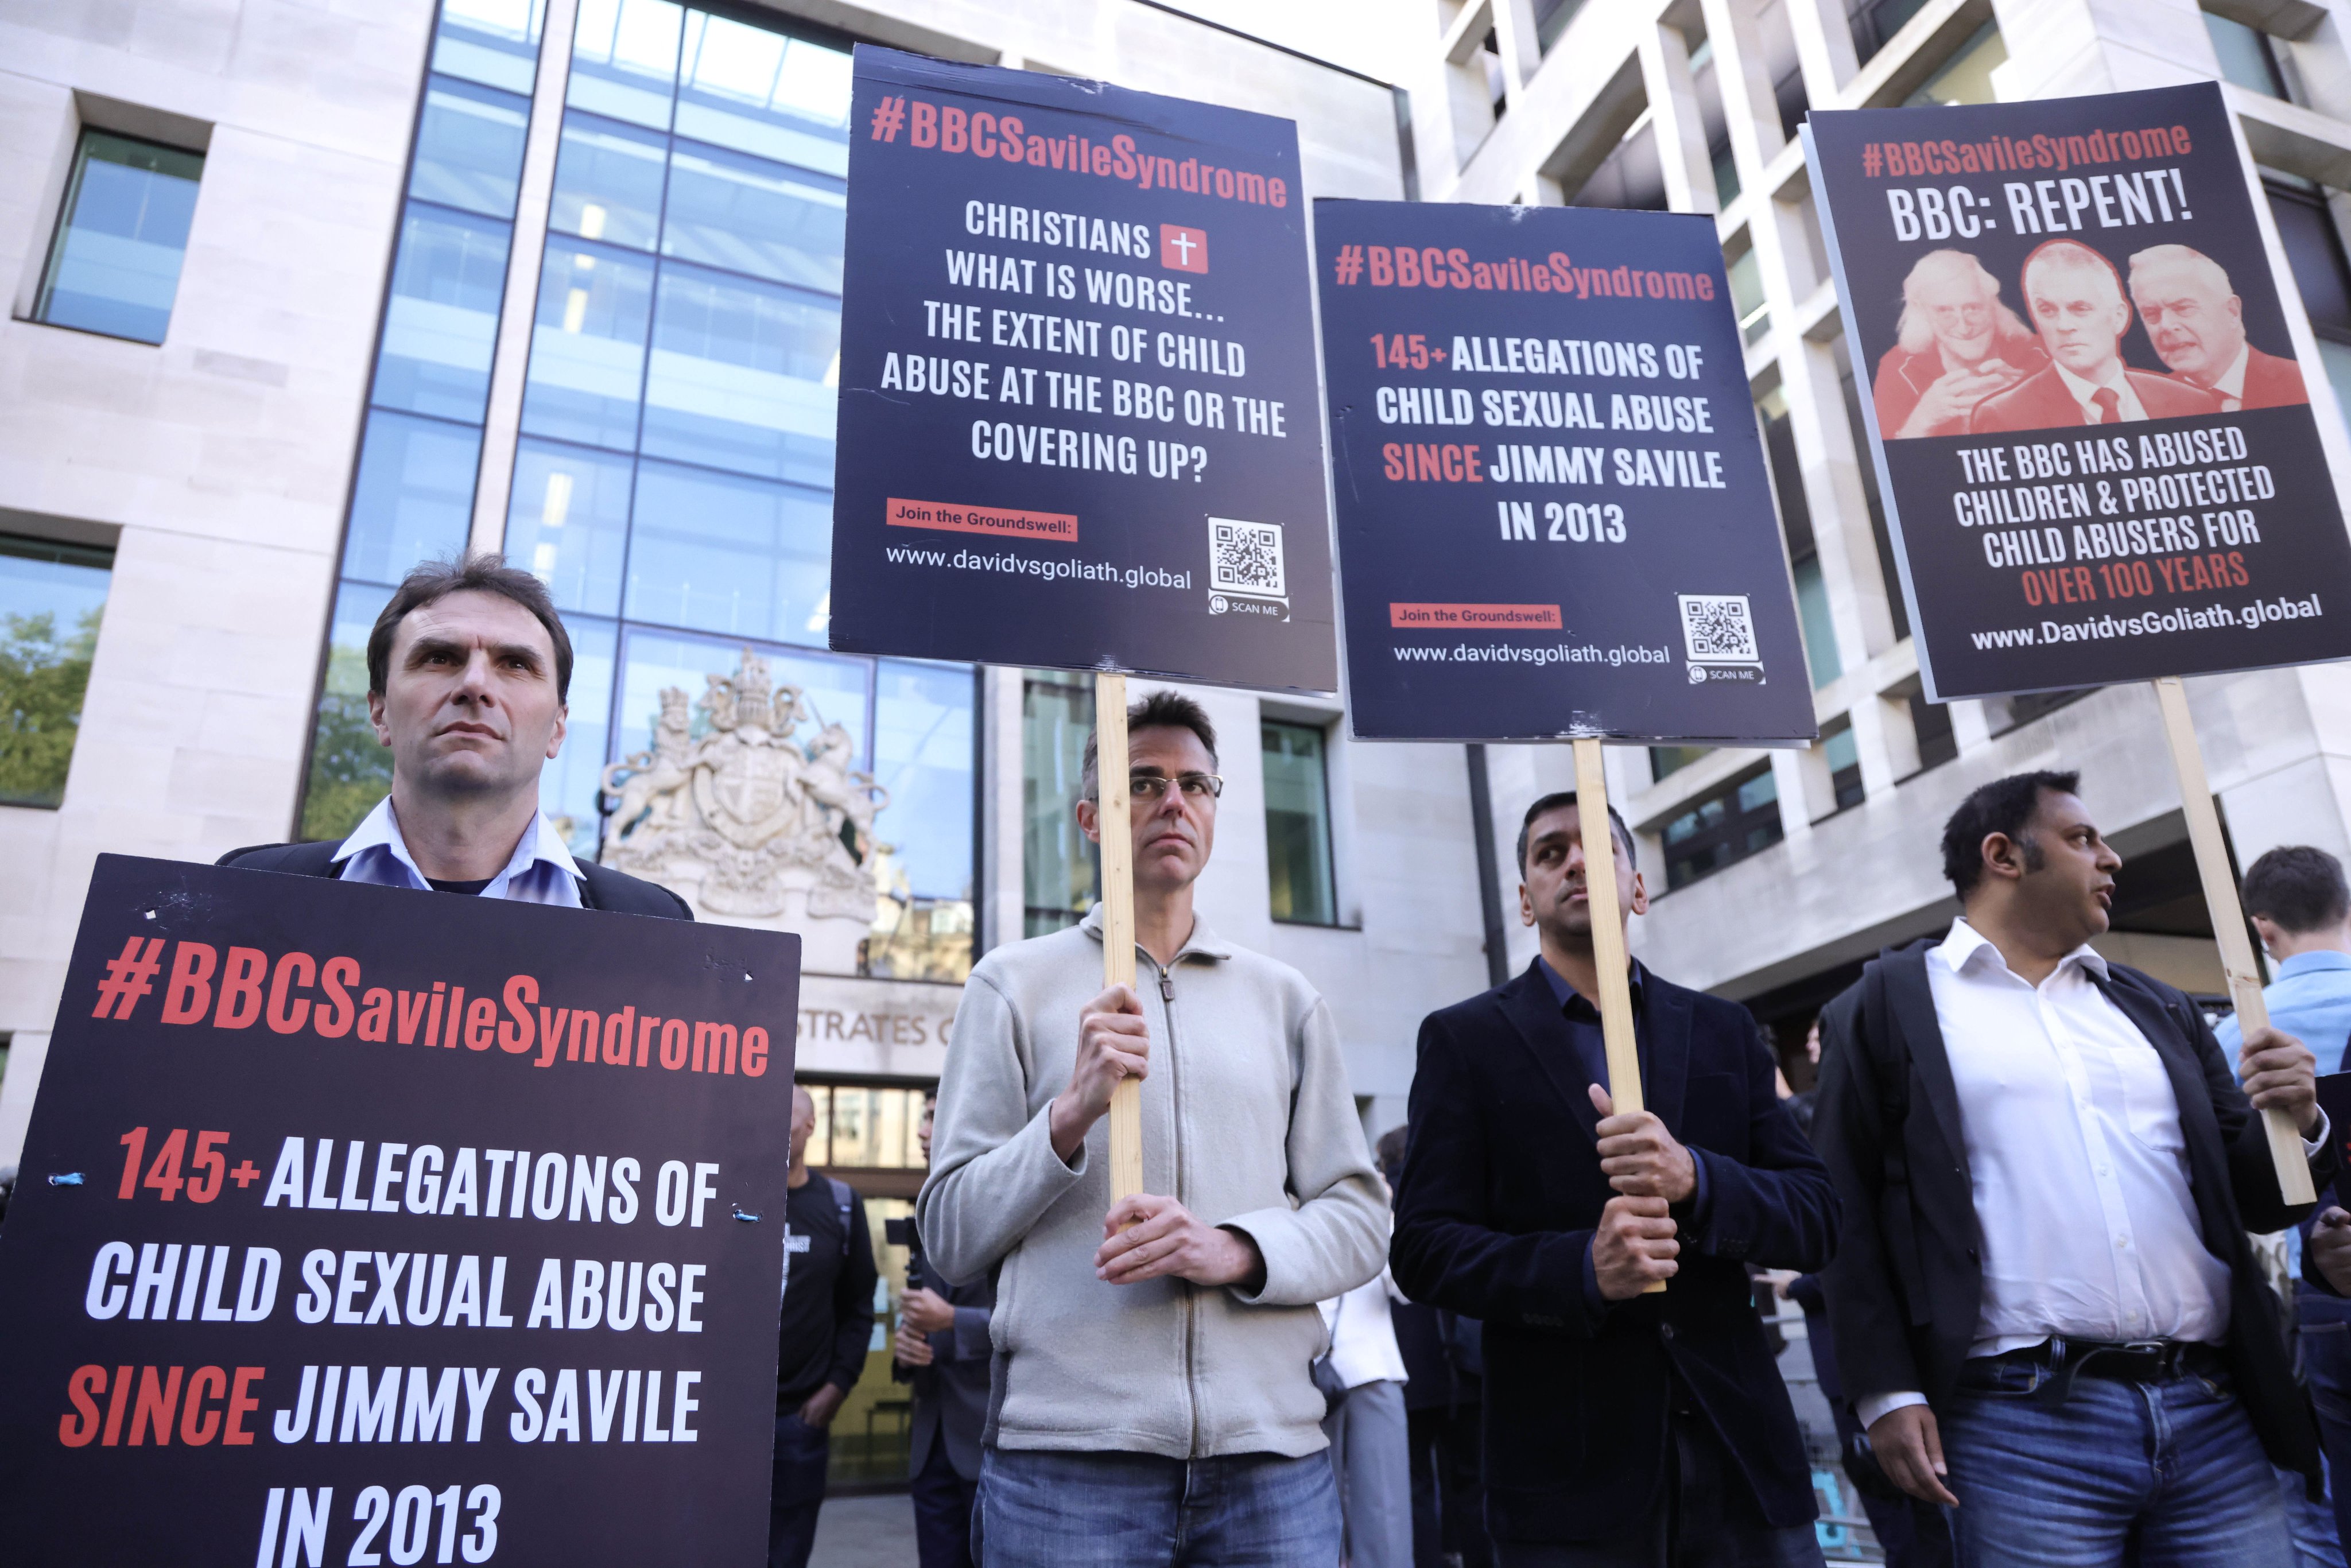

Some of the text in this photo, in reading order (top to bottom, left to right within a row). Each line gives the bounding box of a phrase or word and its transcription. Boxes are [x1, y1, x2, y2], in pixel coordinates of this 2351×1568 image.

[871, 96, 1286, 208] #BBCSavileSyndrome
[1863, 125, 2193, 177] #BBCSavileSyndrome
[966, 200, 1150, 259] CHRISTIANS
[1886, 168, 2193, 241] BBC: REPENT!
[946, 249, 1224, 323] WHAT IS WORSE...
[1335, 245, 1714, 301] #BBCSavileSyndrome
[924, 300, 1246, 377] THE EXTENT OF CHILD
[1371, 334, 1703, 379] 145+ ALLEGATIONS OF
[881, 352, 1287, 438] ABUSE AT THE BBC OR THE
[1376, 387, 1714, 433] CHILD SEXUAL ABUSE
[972, 420, 1208, 483] COVERING UP?
[1384, 444, 1726, 488] SINCE JIMMY SAVILE
[1957, 427, 2248, 484] THE BBC HAS ABUSED
[896, 506, 1071, 534] Join the Groundswell:
[1497, 502, 1627, 543] IN 2013
[1953, 465, 2275, 526] CHILDREN & PROTECTED
[1983, 510, 2261, 568] CHILD ABUSERS FOR
[886, 548, 1191, 590] www.davidvsgoliath.global
[2022, 551, 2249, 607] OVER 100 YEARS
[1232, 602, 1278, 616] SCAN ME
[1399, 610, 1555, 622] Join the Groundswell:
[1971, 594, 2322, 650] www.DavidvsGoliath.global
[1394, 643, 1671, 667] www.davidvsgoliath.global
[1709, 670, 1754, 680] SCAN ME
[92, 937, 769, 1077] #BBCSavileSyndrome
[118, 1127, 719, 1227] 145+ ALLEGATIONS OF
[86, 1241, 281, 1321] CHILD
[296, 1249, 513, 1327] SEXUAL
[527, 1259, 706, 1332] ABUSE
[60, 1365, 701, 1447] SINCE JIMMY SAVILE
[257, 1484, 501, 1568] IN 2013
